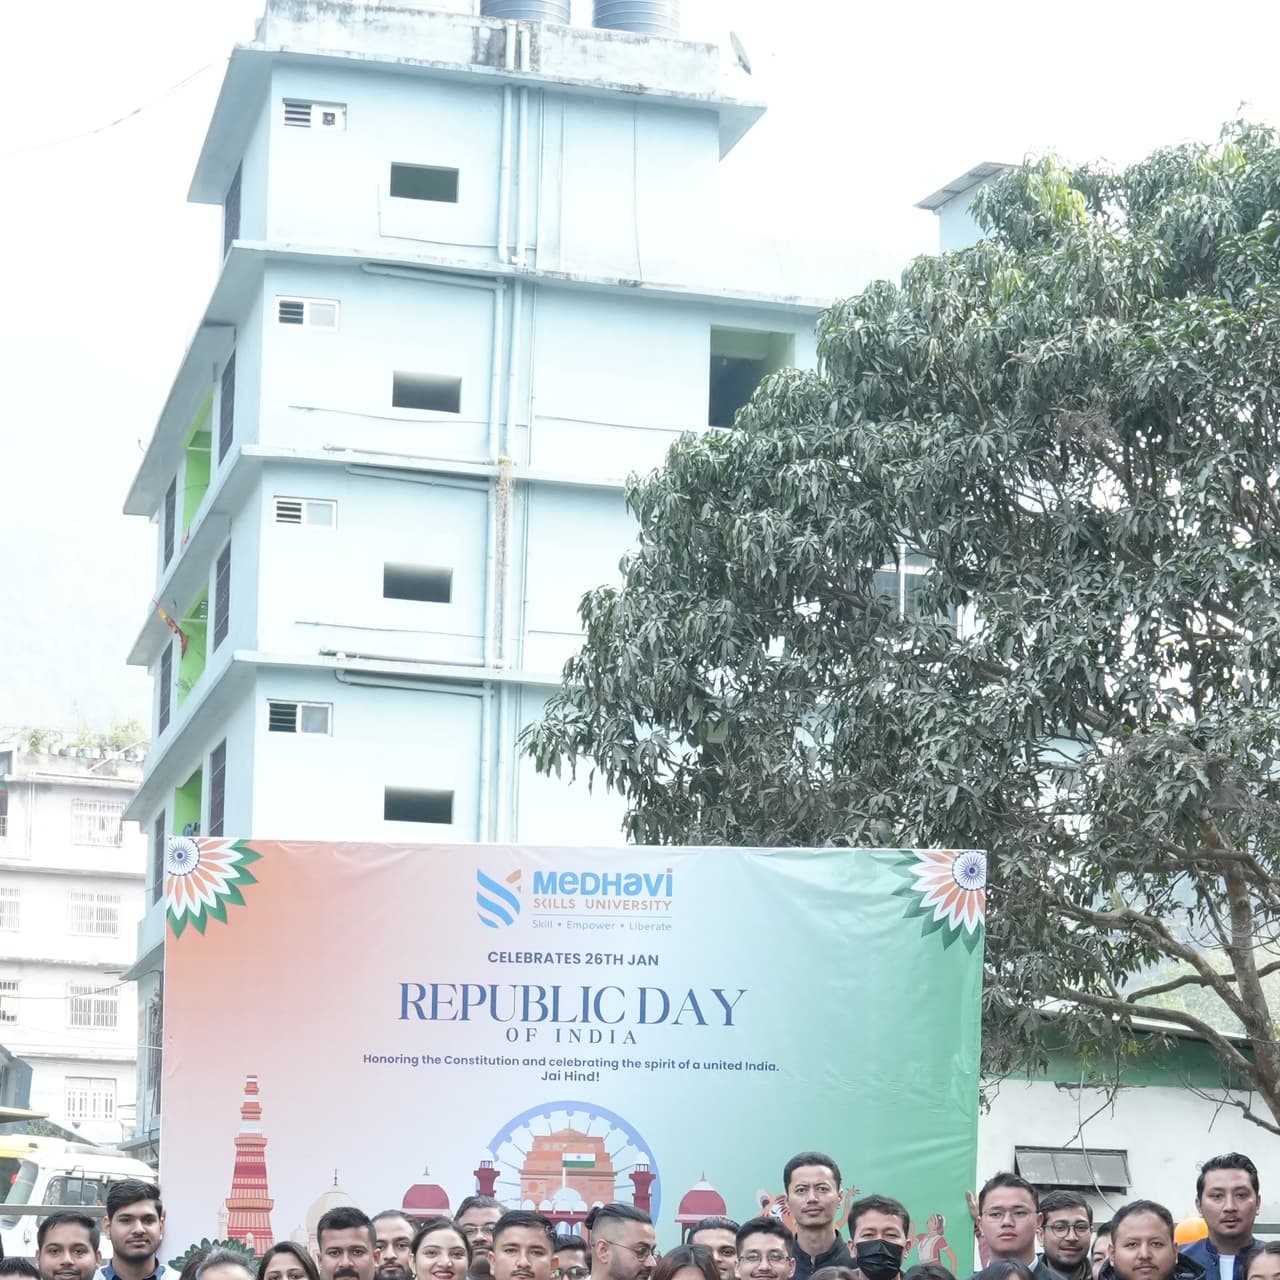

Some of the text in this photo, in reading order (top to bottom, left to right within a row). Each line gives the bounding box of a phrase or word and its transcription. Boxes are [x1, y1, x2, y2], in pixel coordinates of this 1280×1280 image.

[533, 898, 673, 911] SKILLS UNIVERSITY
[532, 919, 672, 932] Skill Empower Liberate
[487, 951, 660, 967] CELEBRATES 26TH JAN
[398, 982, 749, 1026] REPUBLIC DAY
[505, 1027, 638, 1045] OF INDIA
[363, 1054, 780, 1072] Honoring the Constitution and celebrating the spirit of a united India.
[541, 1071, 600, 1082] Jai Hind!
